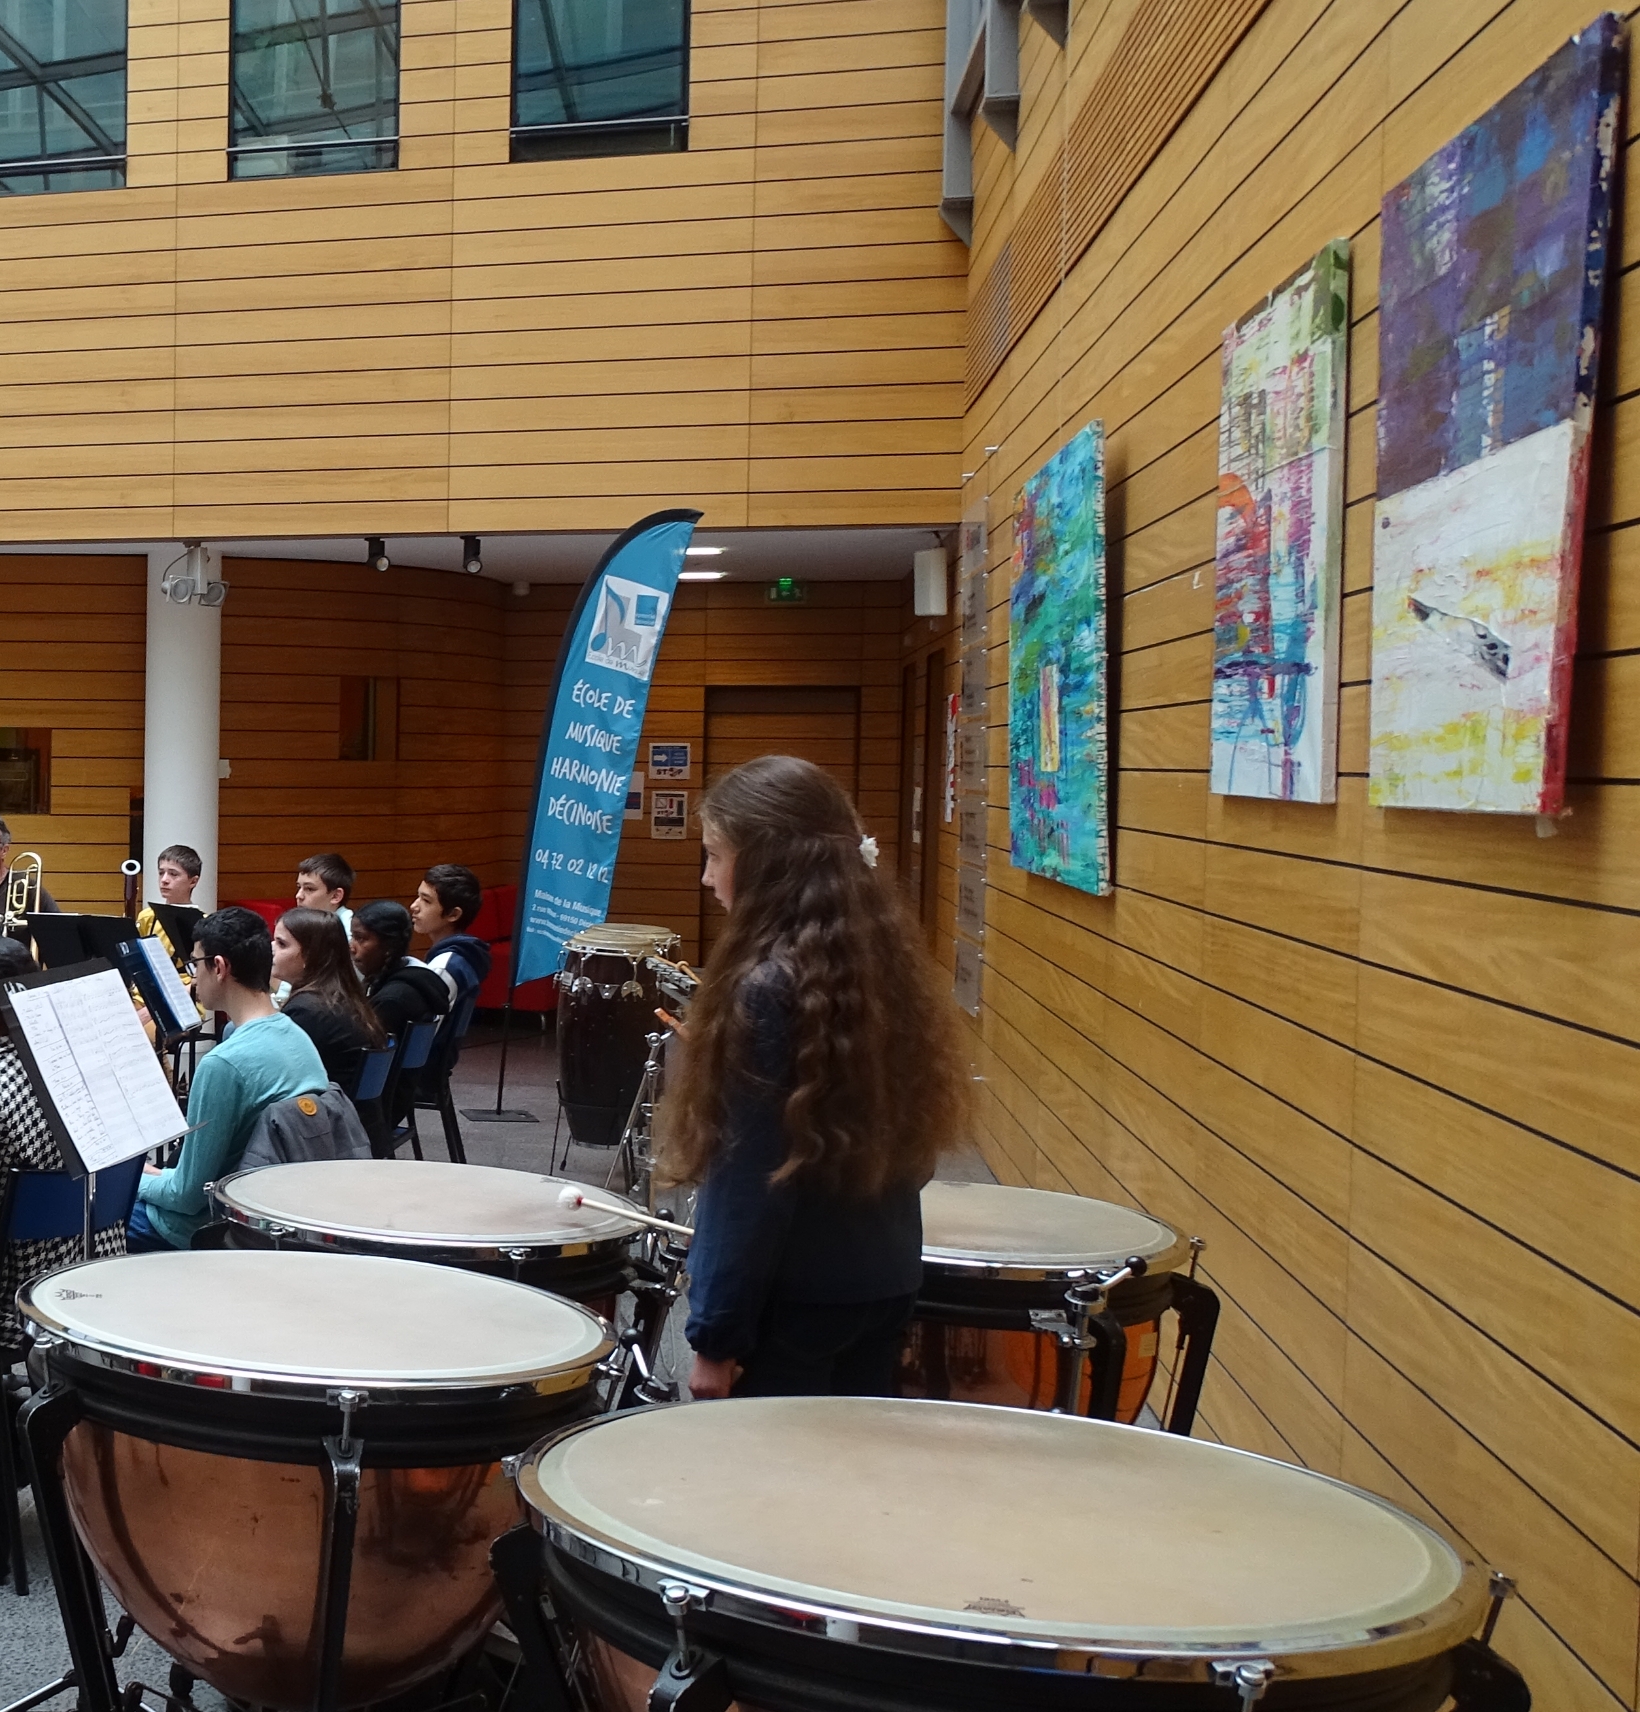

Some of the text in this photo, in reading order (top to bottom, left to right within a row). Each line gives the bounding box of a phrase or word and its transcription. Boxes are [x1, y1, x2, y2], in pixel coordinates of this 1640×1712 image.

[572, 679, 635, 718] ÉCOLE DE
[565, 721, 623, 755] MUSIQUE
[550, 757, 626, 796] HARMONIE
[547, 794, 613, 834] DÉCINOISE
[535, 849, 608, 883] 04 72 02 12 12
[572, 901, 602, 917] Musique
